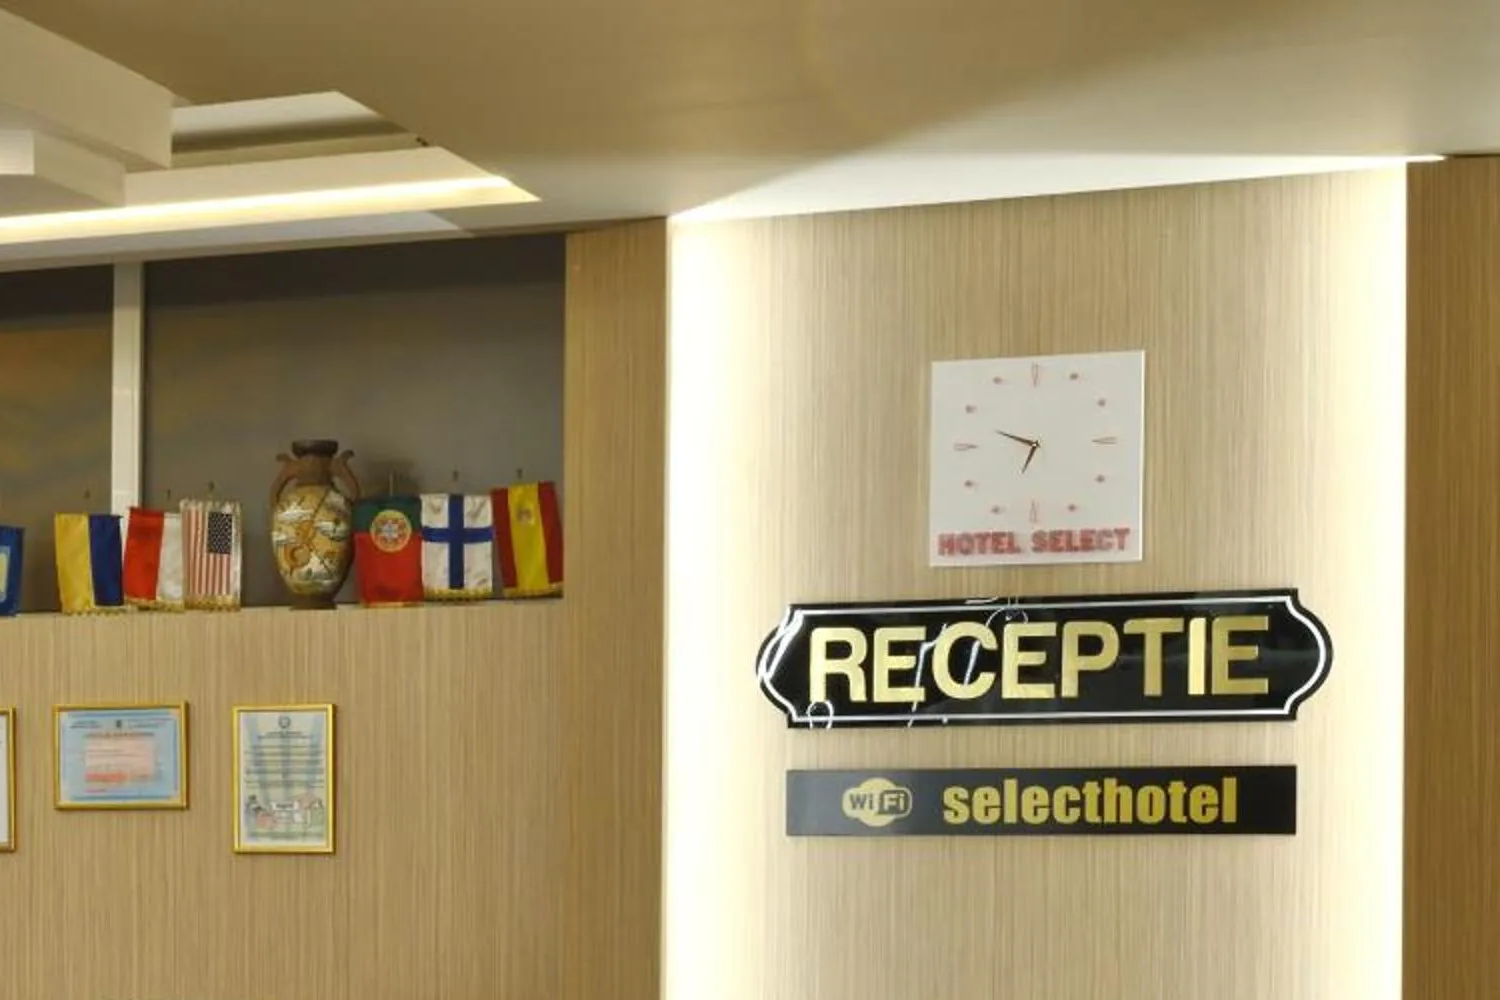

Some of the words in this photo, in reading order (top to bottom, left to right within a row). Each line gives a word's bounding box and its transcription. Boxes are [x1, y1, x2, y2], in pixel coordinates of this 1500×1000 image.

[938, 531, 1021, 556] HOTEL
[1031, 528, 1131, 553] SELECT
[808, 614, 1271, 704] RECEPTIE
[942, 776, 1238, 825] selecthotel
